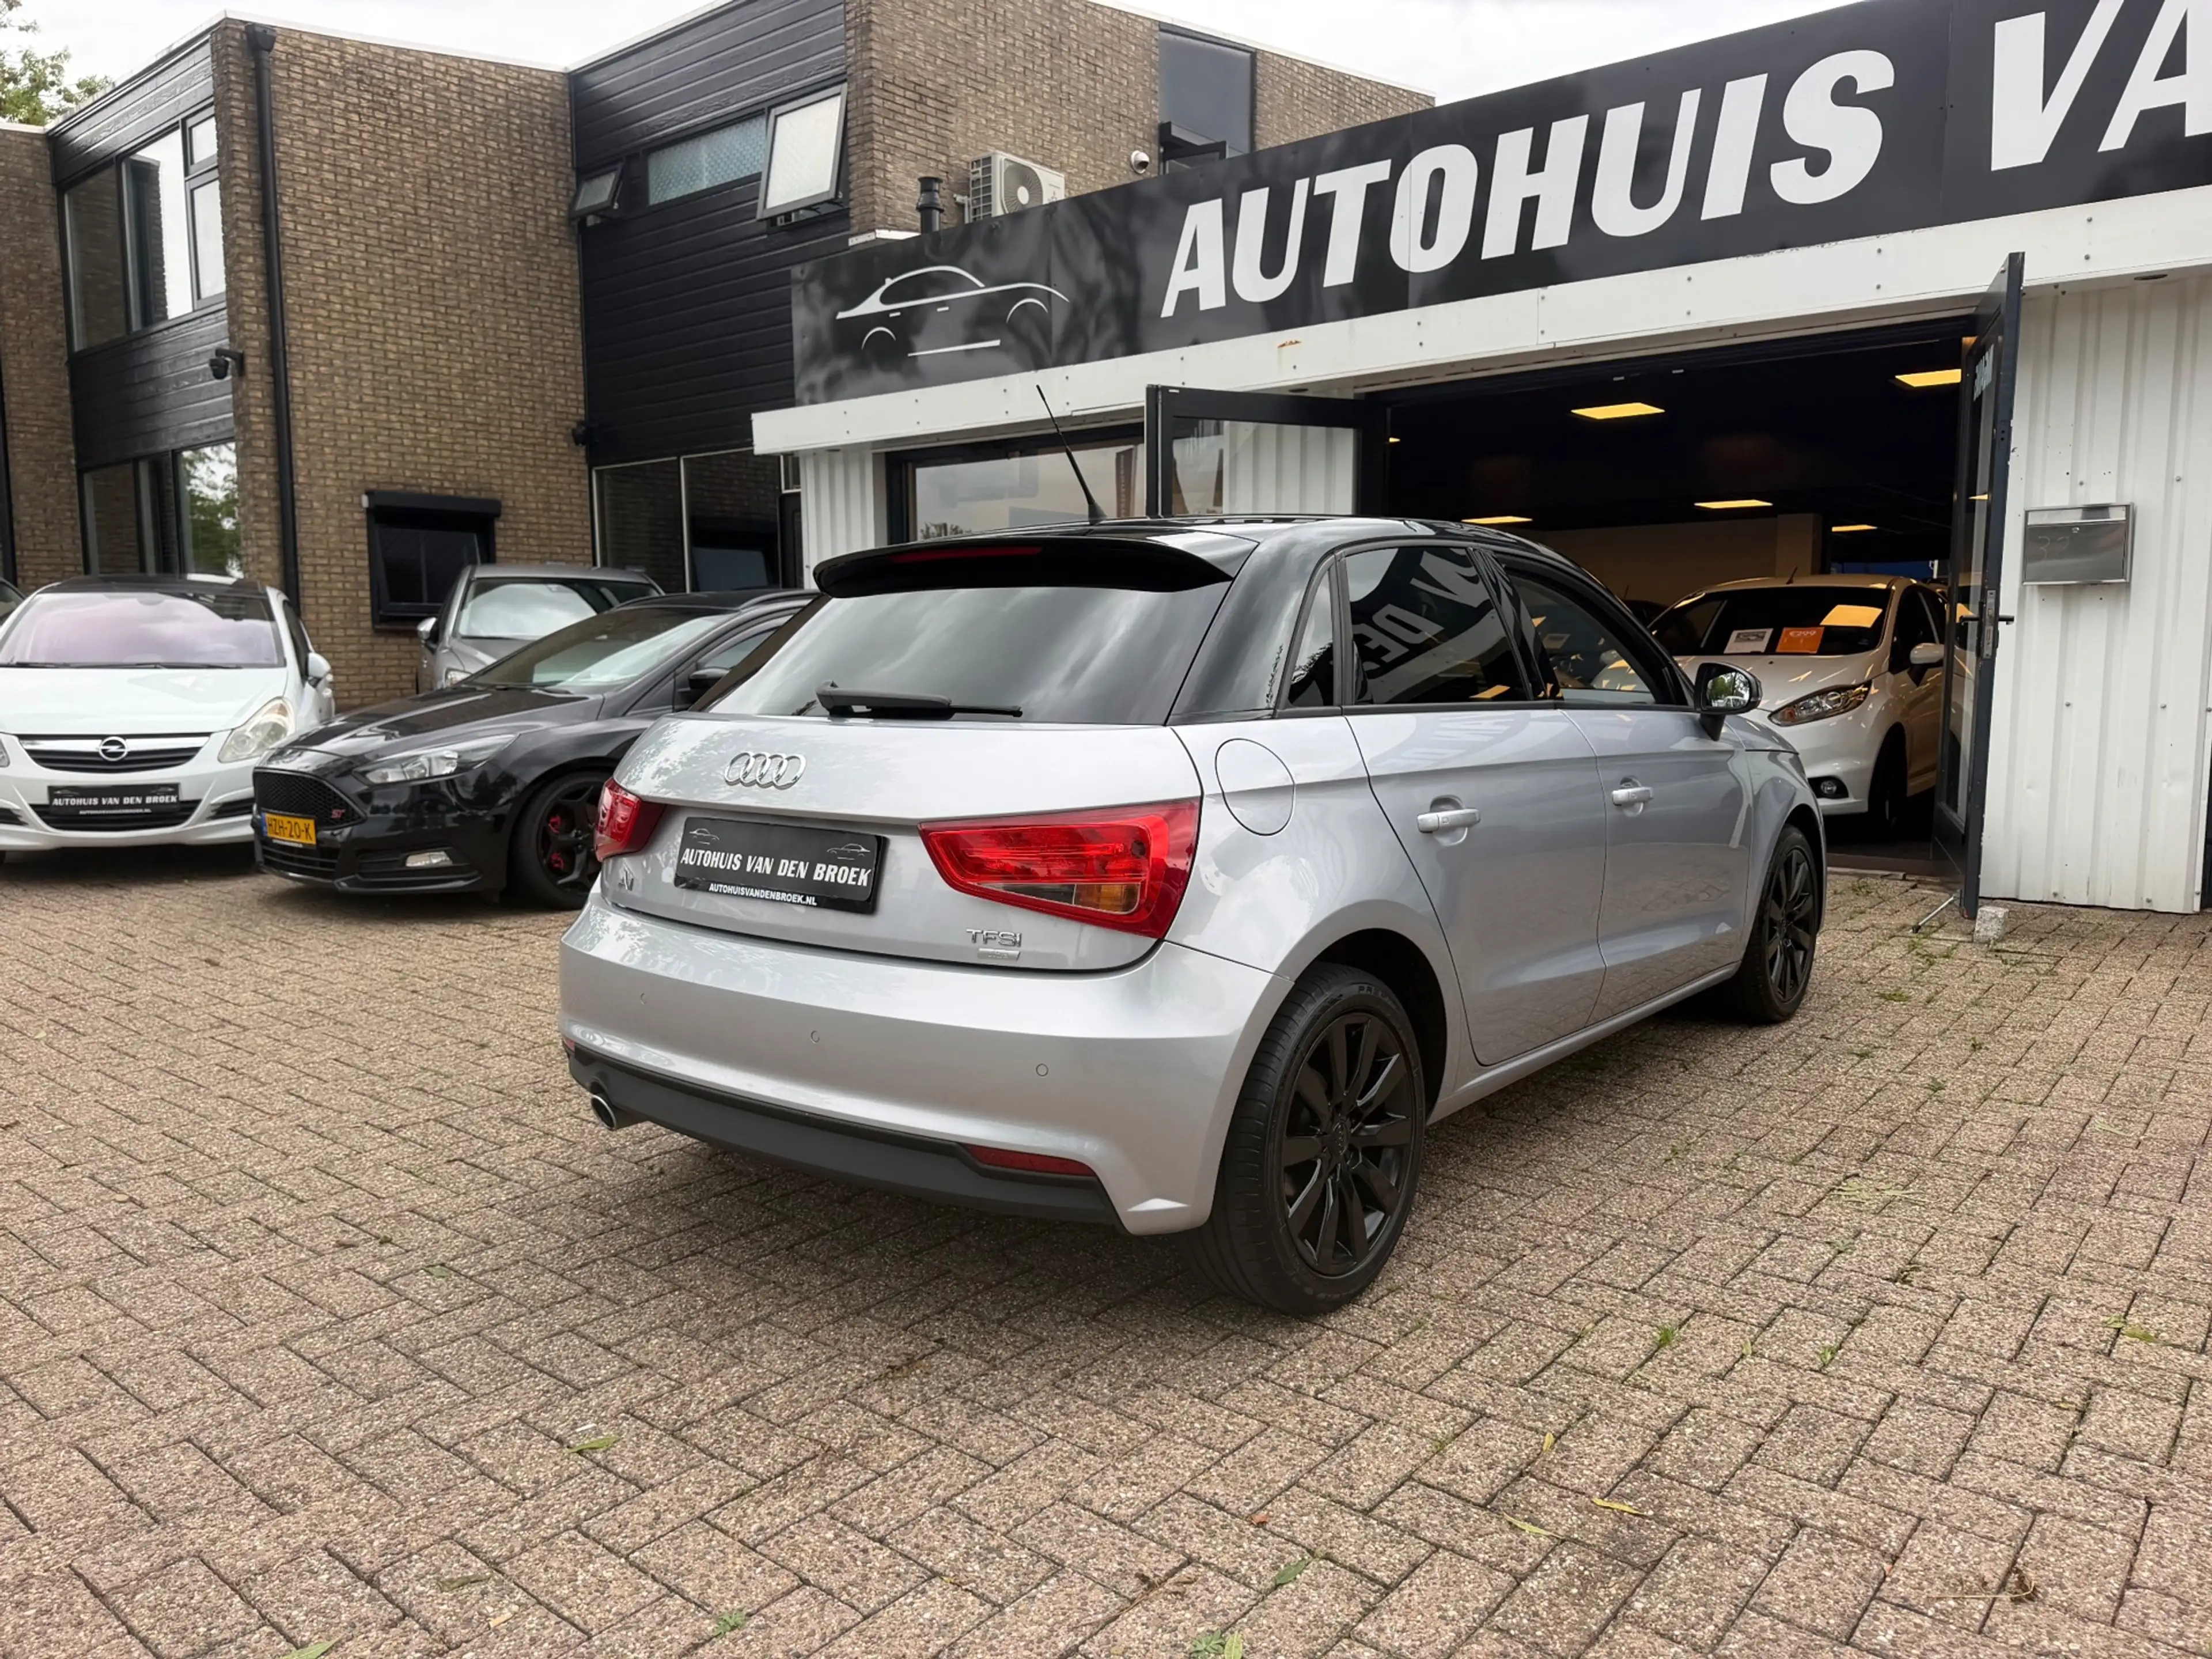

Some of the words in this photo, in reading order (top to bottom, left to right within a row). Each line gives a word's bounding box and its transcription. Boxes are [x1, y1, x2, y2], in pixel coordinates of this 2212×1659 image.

[1161, 50, 1895, 317] AUTOHUIS
[1991, 0, 2212, 171] VA
[52, 797, 99, 806] AUTOHUIS
[101, 797, 120, 805] VAN
[123, 796, 142, 805] DEN
[145, 795, 177, 804] BROEK
[680, 848, 743, 871] AUTOHUIS
[746, 855, 774, 874] VAN
[777, 859, 809, 879] DEN
[813, 863, 872, 887] BROEK
[709, 883, 817, 906] AUTOHUISVANDENBROEK.NL
[966, 929, 1021, 947] TFSI
